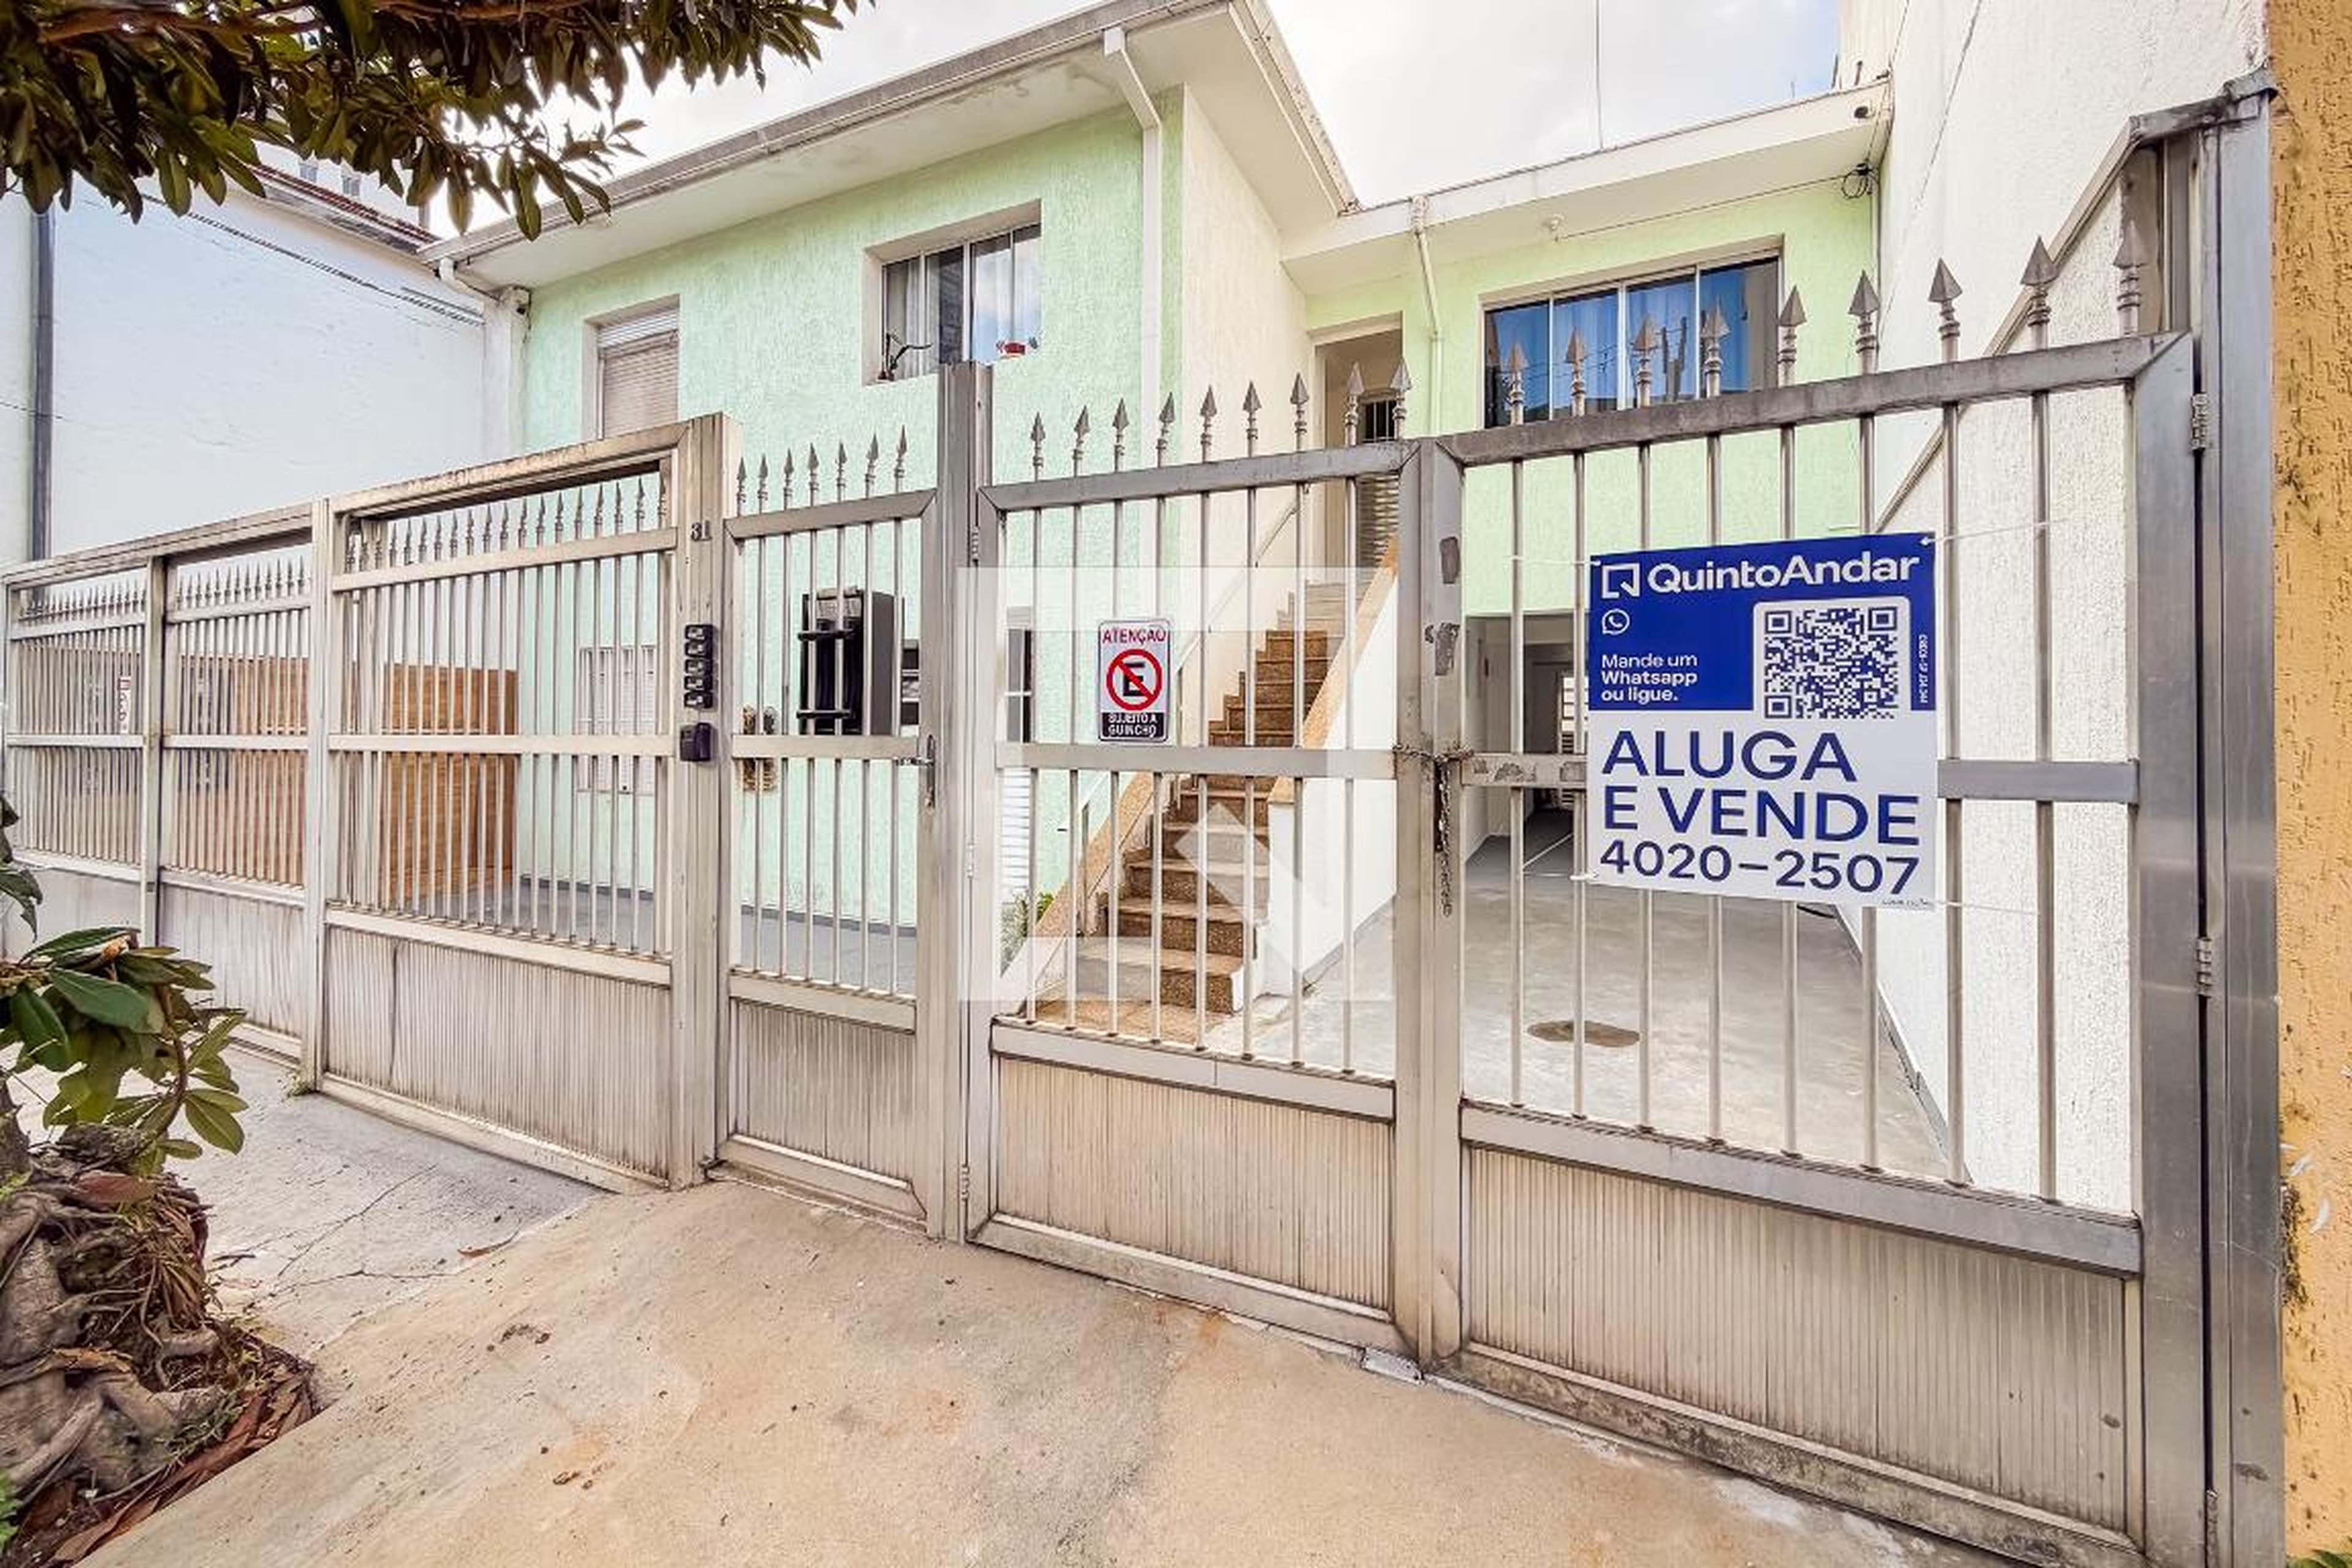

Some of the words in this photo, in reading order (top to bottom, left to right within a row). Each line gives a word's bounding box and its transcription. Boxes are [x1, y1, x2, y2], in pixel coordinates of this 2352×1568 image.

[1647, 551, 1920, 594] QuintoAndar
[1601, 654, 1663, 668] Mande
[1667, 655, 1697, 667] um
[1600, 671, 1698, 687] Whatsapp
[1600, 690, 1624, 702] ou
[1627, 688, 1678, 704] ligue.
[1150, 714, 1158, 724] A
[1108, 724, 1156, 737] GUINCHO
[1602, 731, 1857, 783] ALUGA
[1604, 785, 1638, 831] E
[1657, 787, 1920, 846] VENDE
[1600, 840, 1920, 895] 4020-2507
